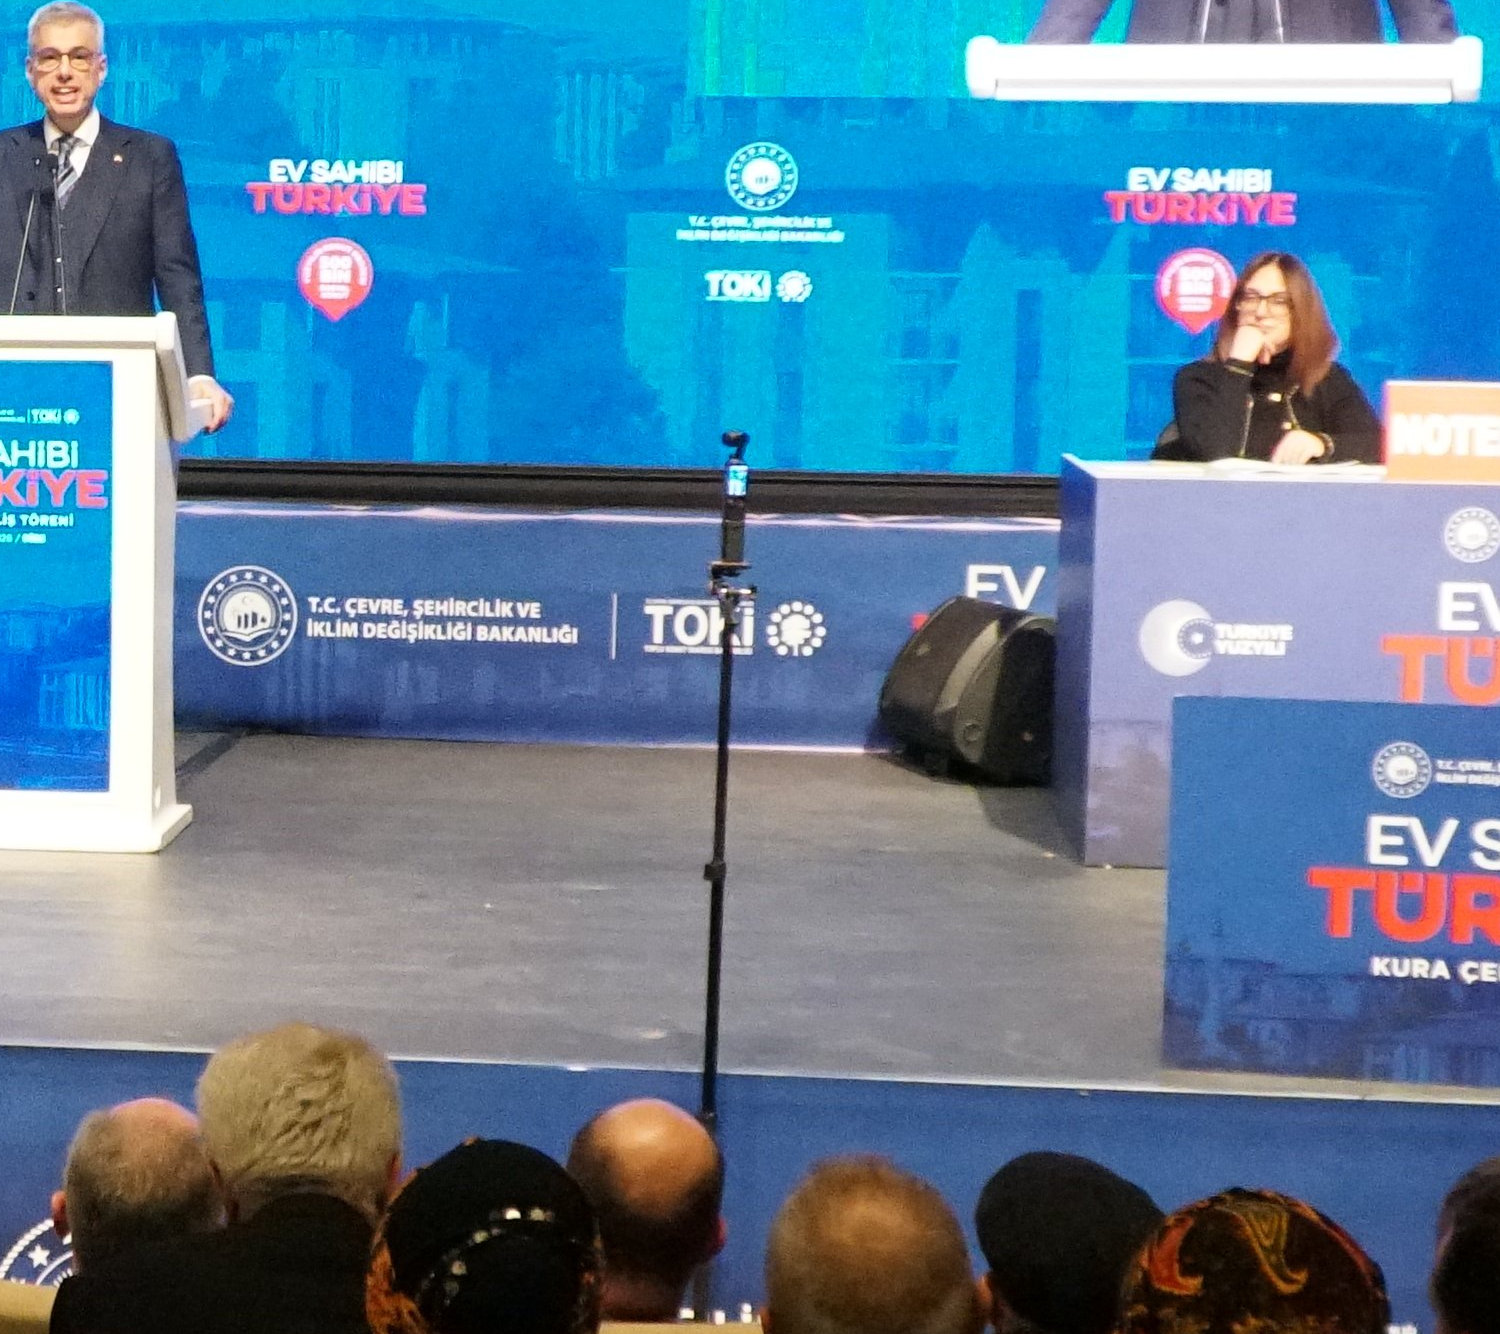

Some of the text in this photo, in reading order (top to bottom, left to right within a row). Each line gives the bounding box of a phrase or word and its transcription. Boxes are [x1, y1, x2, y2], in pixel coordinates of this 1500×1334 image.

[269, 159, 307, 183] EV
[1128, 167, 1171, 192] EV
[966, 564, 1046, 611] EV
[307, 596, 541, 621] T.C. ÇEVRE, ŞEHİRCİLİK VE
[306, 618, 357, 640] İKLİM
[476, 622, 578, 644] BAKANLIĞI
[1367, 814, 1459, 867] EV
[1370, 956, 1450, 980] KURA
